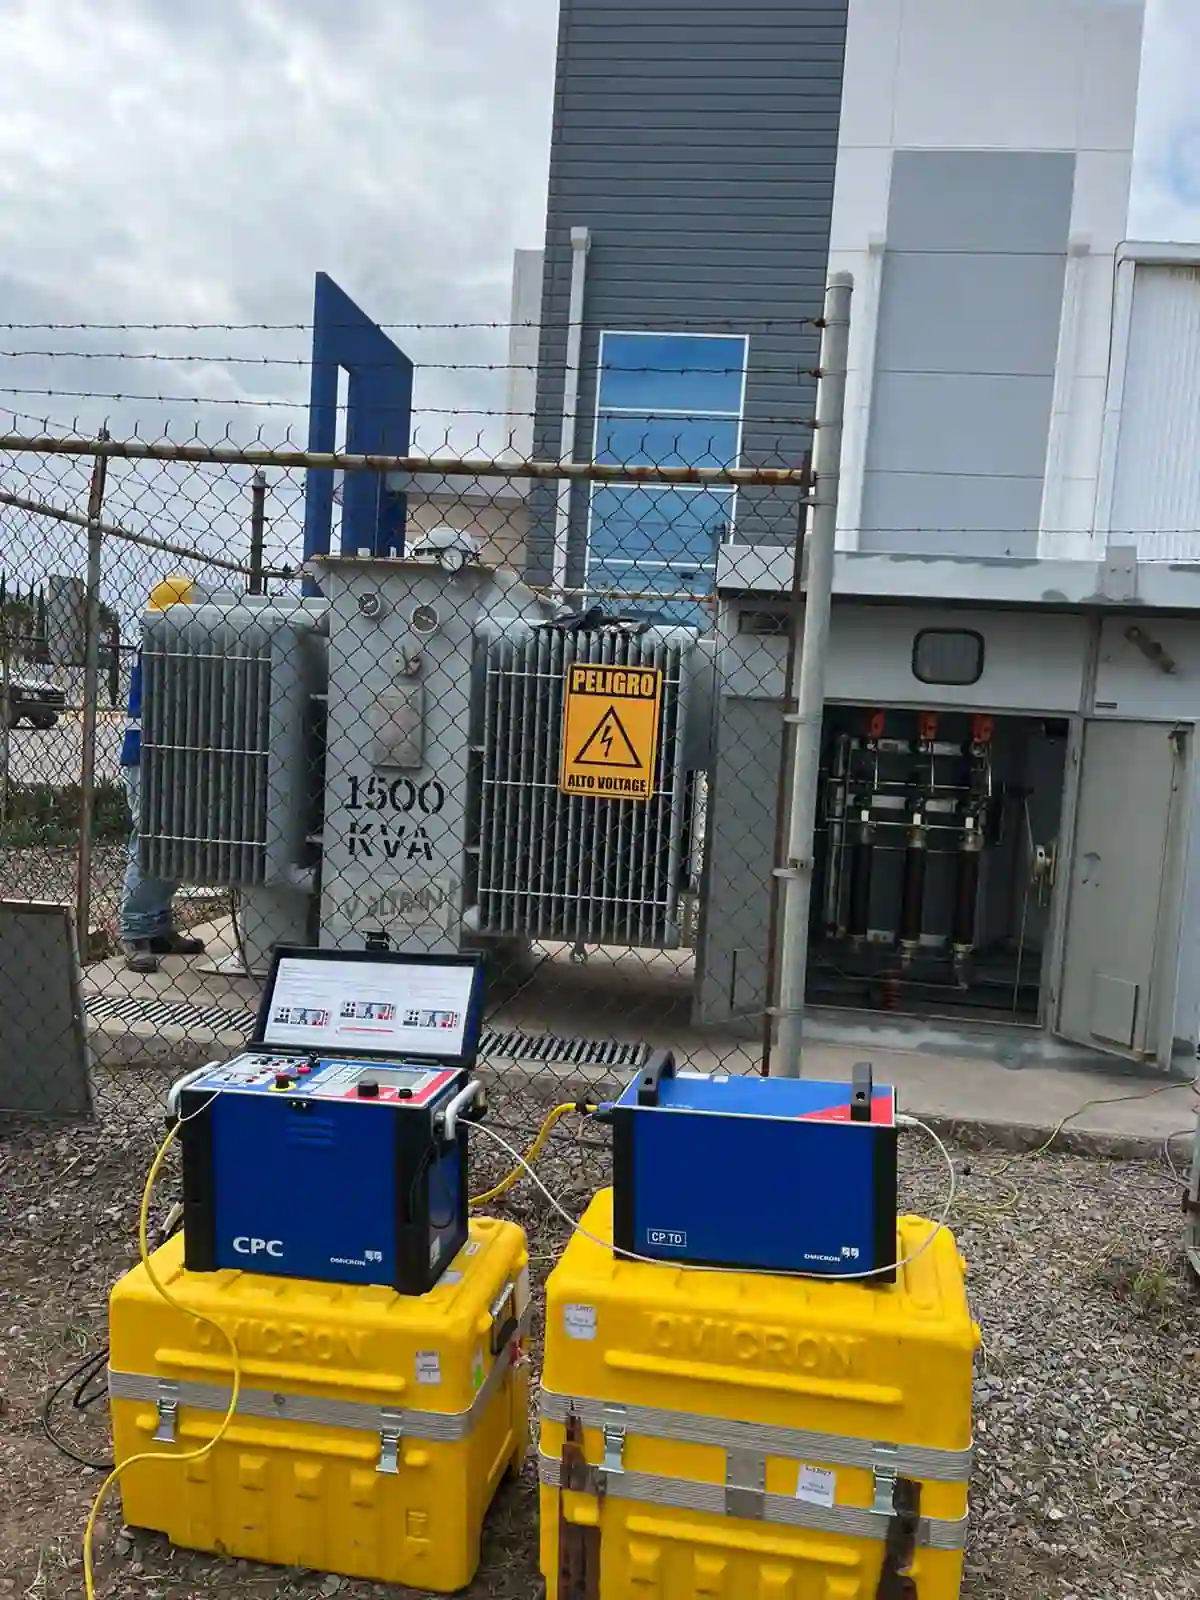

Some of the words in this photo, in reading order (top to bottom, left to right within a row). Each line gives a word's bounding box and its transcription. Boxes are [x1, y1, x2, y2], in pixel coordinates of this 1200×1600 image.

[572, 669, 655, 697] PELIGRO
[567, 774, 595, 789] ALTO
[598, 776, 648, 793] VOLTAGE
[343, 775, 445, 814] 1500
[348, 822, 433, 861] KVA
[232, 1236, 284, 1257] CPC
[652, 1231, 666, 1242] CP
[803, 1253, 841, 1262] OMICRON
